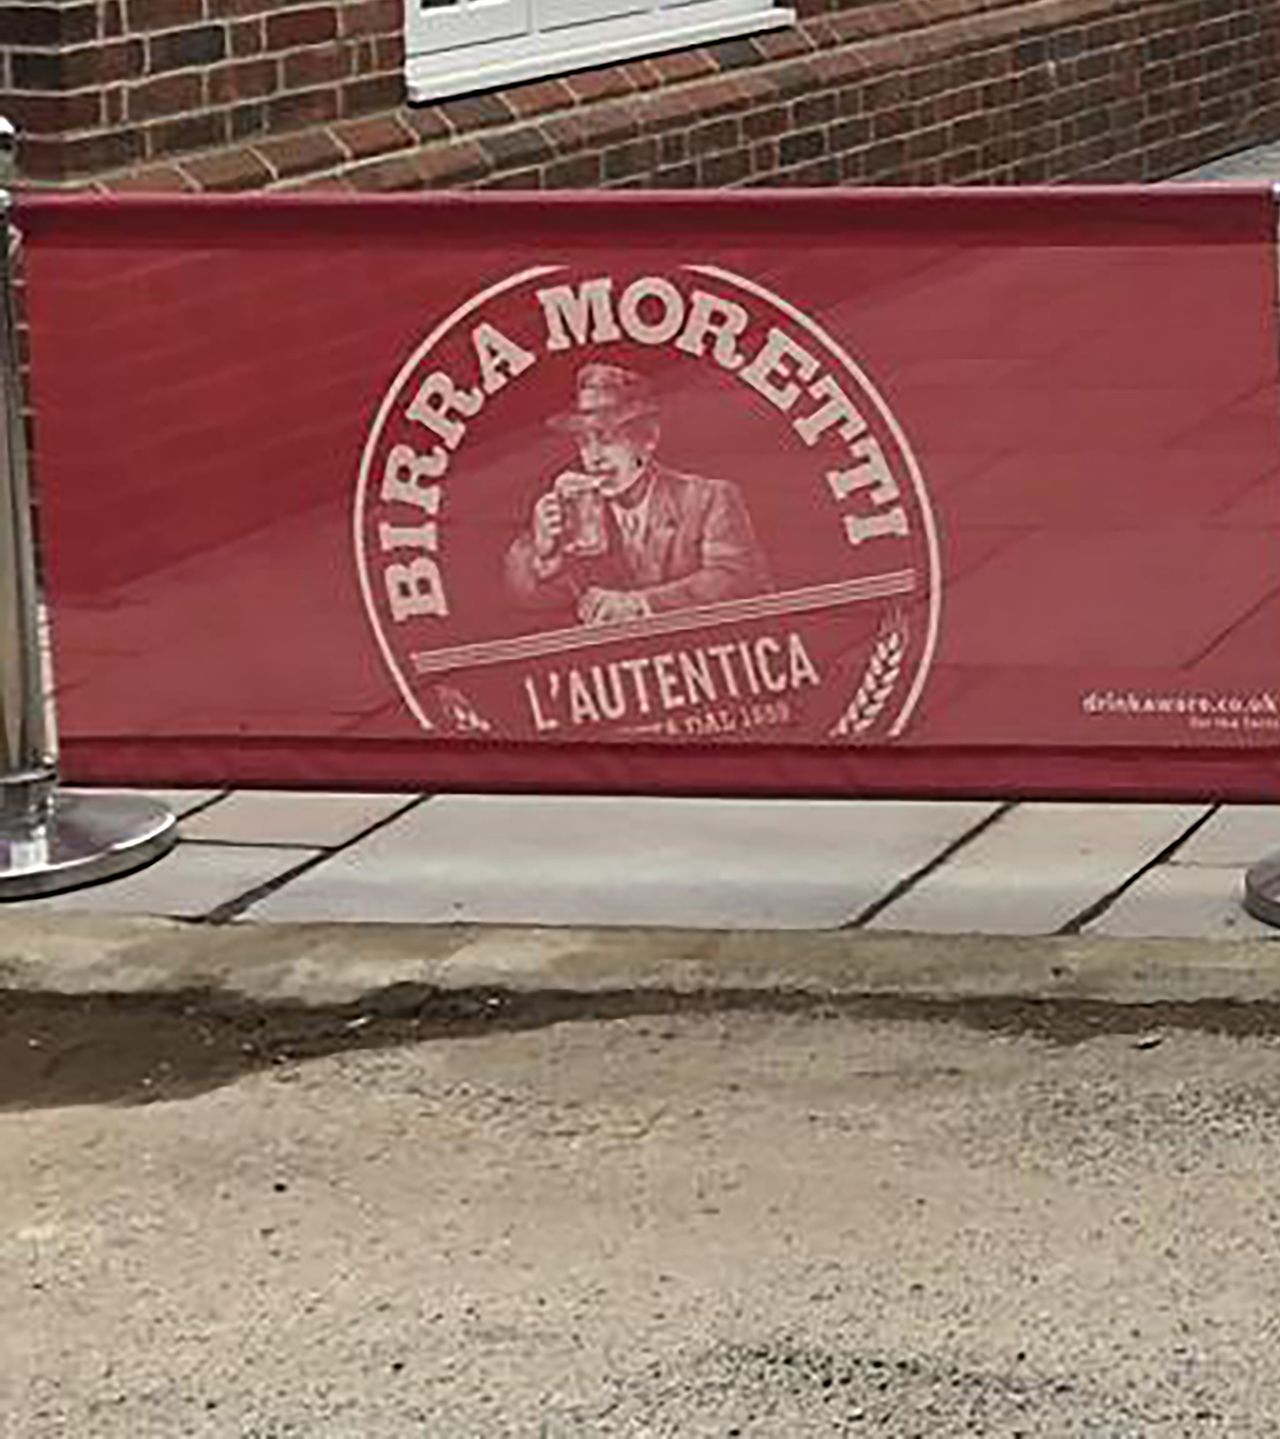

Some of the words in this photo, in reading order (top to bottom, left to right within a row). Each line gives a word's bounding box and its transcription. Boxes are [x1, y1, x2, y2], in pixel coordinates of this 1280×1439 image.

[379, 320, 537, 622] BIRRA
[535, 275, 911, 546] MORETTI
[524, 632, 821, 732] L'AUTENTICA
